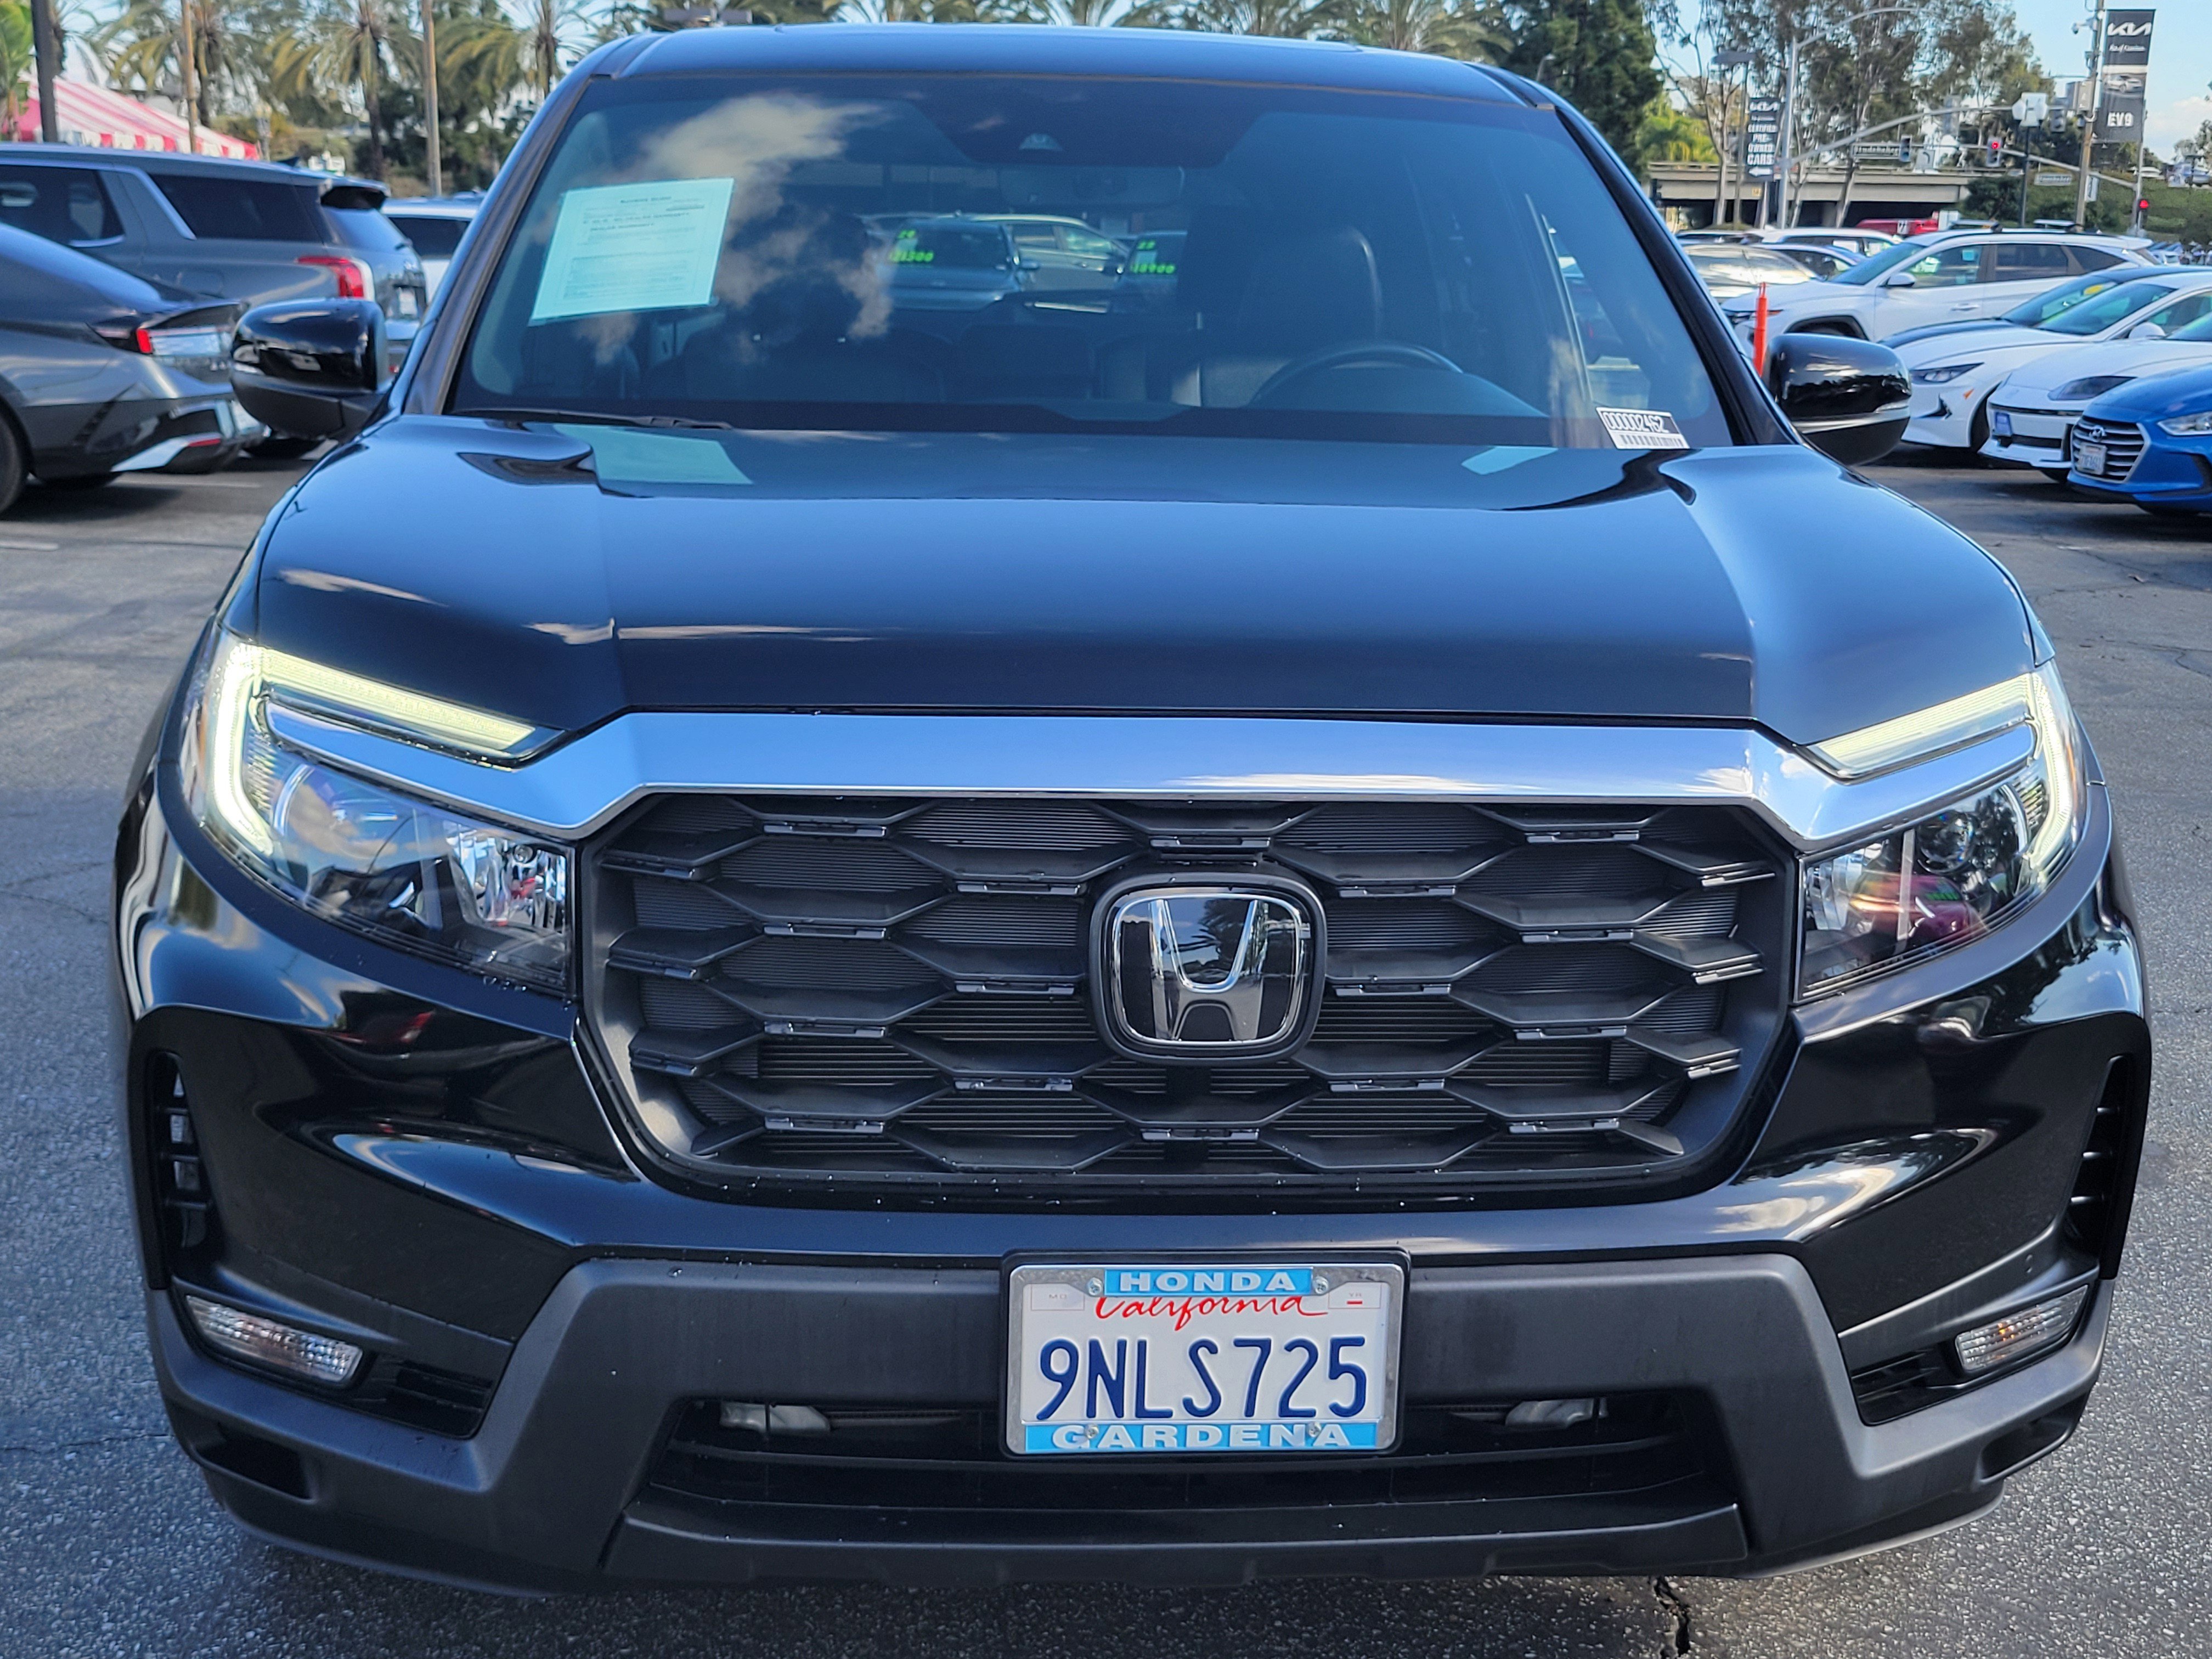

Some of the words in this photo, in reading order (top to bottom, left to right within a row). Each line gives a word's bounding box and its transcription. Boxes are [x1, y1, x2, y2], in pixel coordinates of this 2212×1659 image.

[2107, 112, 2134, 127] EV9
[1748, 143, 1775, 153] OWNED
[1747, 154, 1774, 165] CARS
[1120, 1271, 1296, 1292] HONDA
[1036, 1336, 1367, 1420] 9NLS725
[1052, 1424, 1351, 1449] GARDENA
